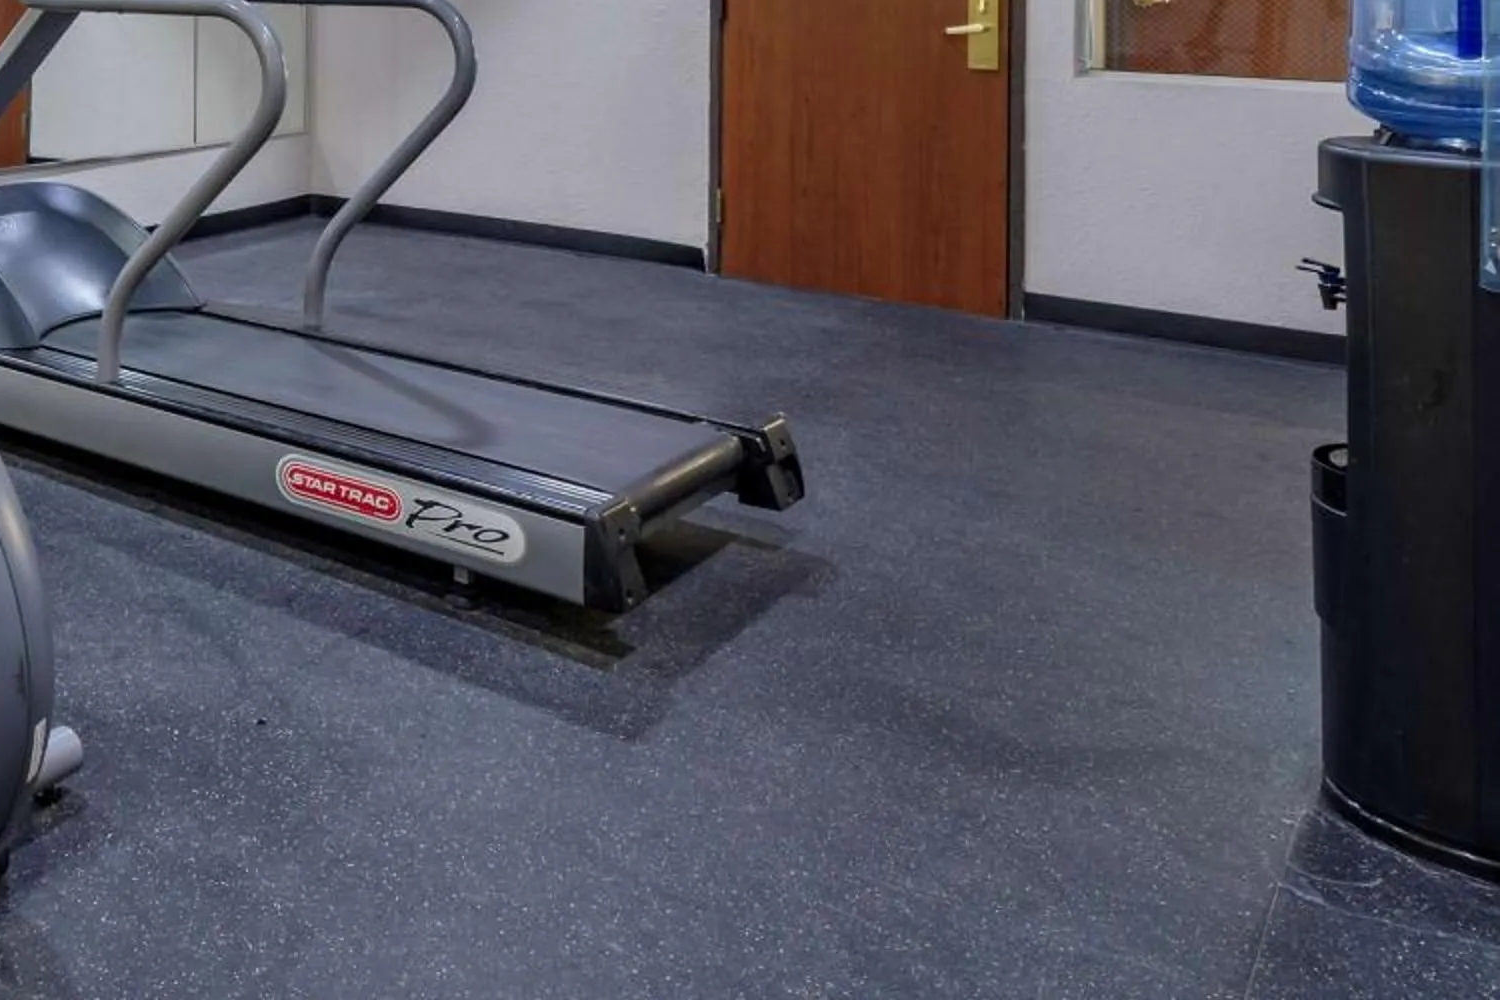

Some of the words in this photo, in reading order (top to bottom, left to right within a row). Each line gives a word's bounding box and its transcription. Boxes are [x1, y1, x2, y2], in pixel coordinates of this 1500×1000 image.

[288, 472, 337, 496] STAR
[339, 485, 393, 511] TRAC
[405, 496, 510, 543] Pro
